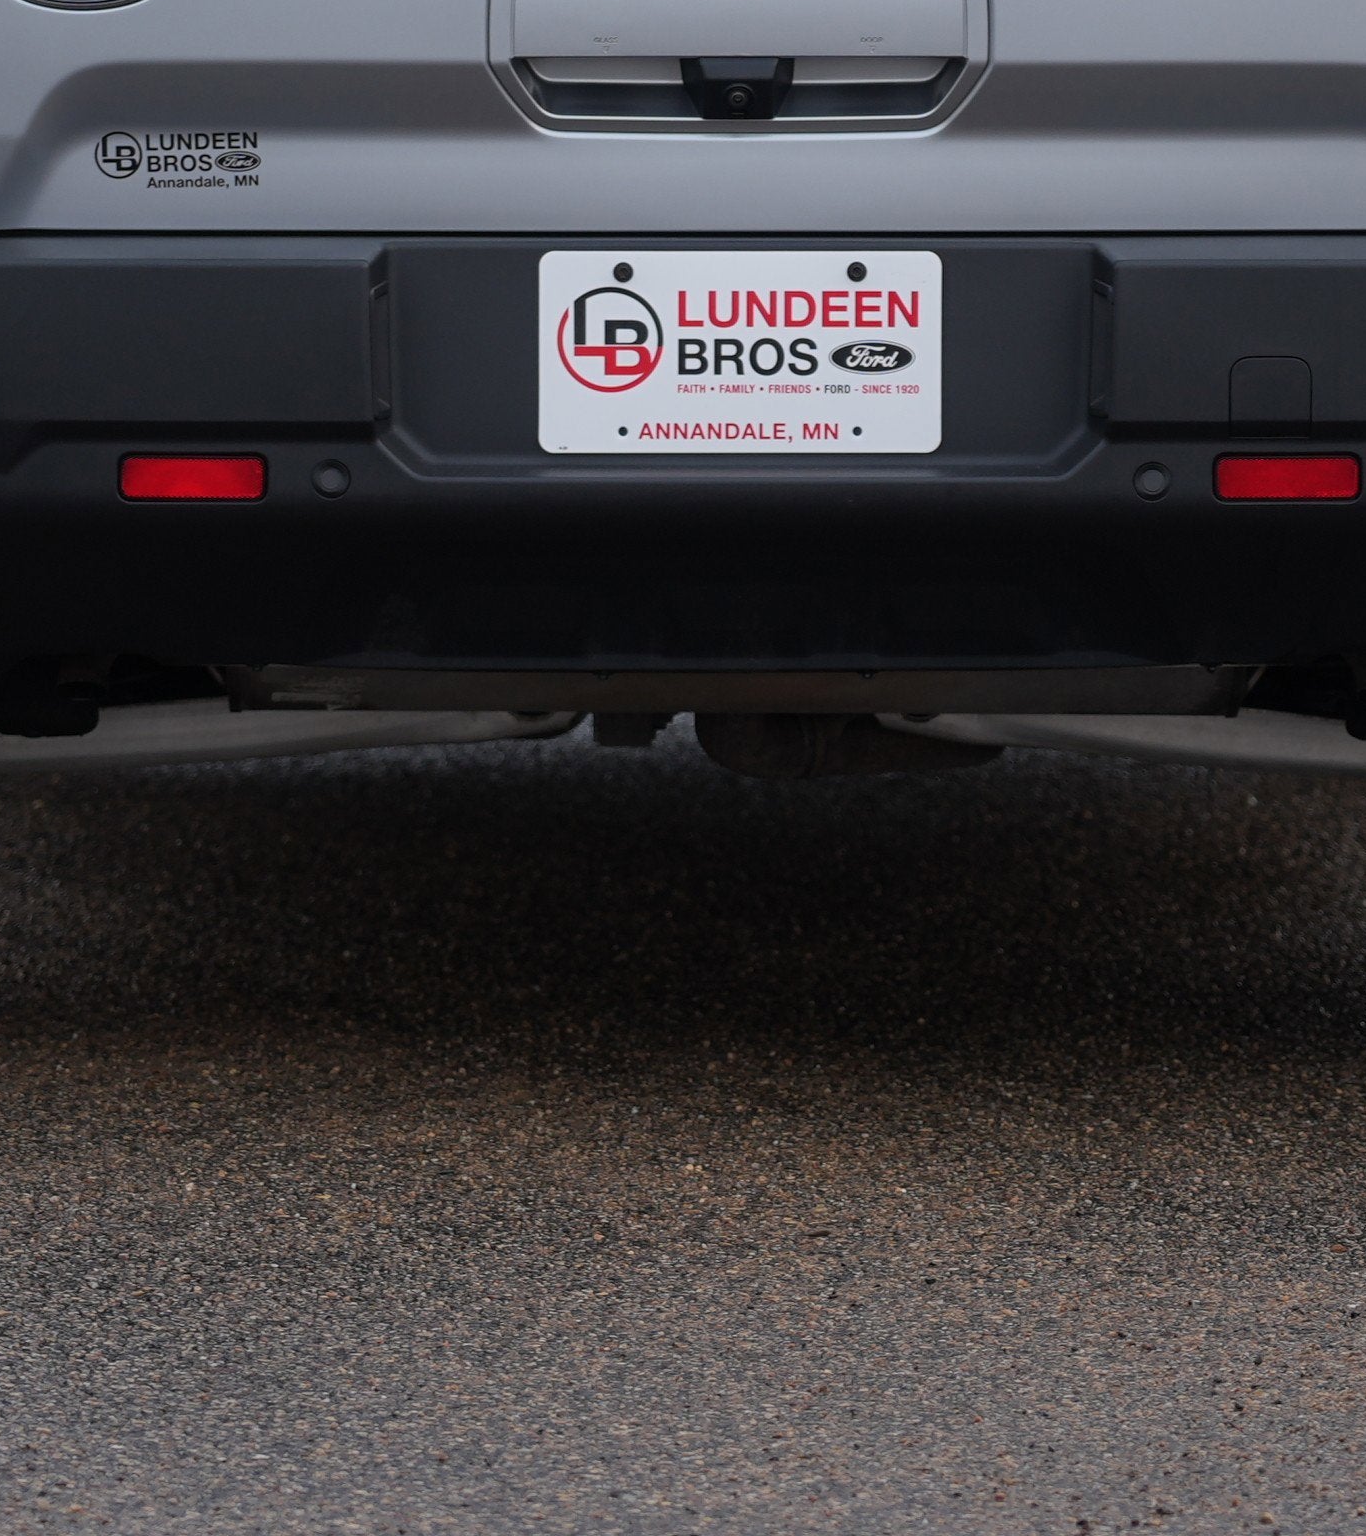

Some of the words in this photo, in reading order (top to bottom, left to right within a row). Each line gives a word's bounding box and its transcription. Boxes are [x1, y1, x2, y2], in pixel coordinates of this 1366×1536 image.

[145, 132, 258, 150] LUNDEEN
[147, 154, 213, 172] BROS
[146, 175, 230, 189] Annandale,
[234, 175, 259, 186] MN
[677, 290, 920, 328] LUNDEEN
[677, 338, 819, 376] BROS
[677, 384, 706, 394] FAITH
[719, 384, 756, 394] FAMILY
[768, 384, 812, 394] FRIENDS
[824, 384, 851, 394] FORD
[861, 384, 892, 394] SINCE
[895, 384, 920, 394] 1920
[639, 423, 794, 443] ANNANDALE,
[802, 423, 840, 440] MN
